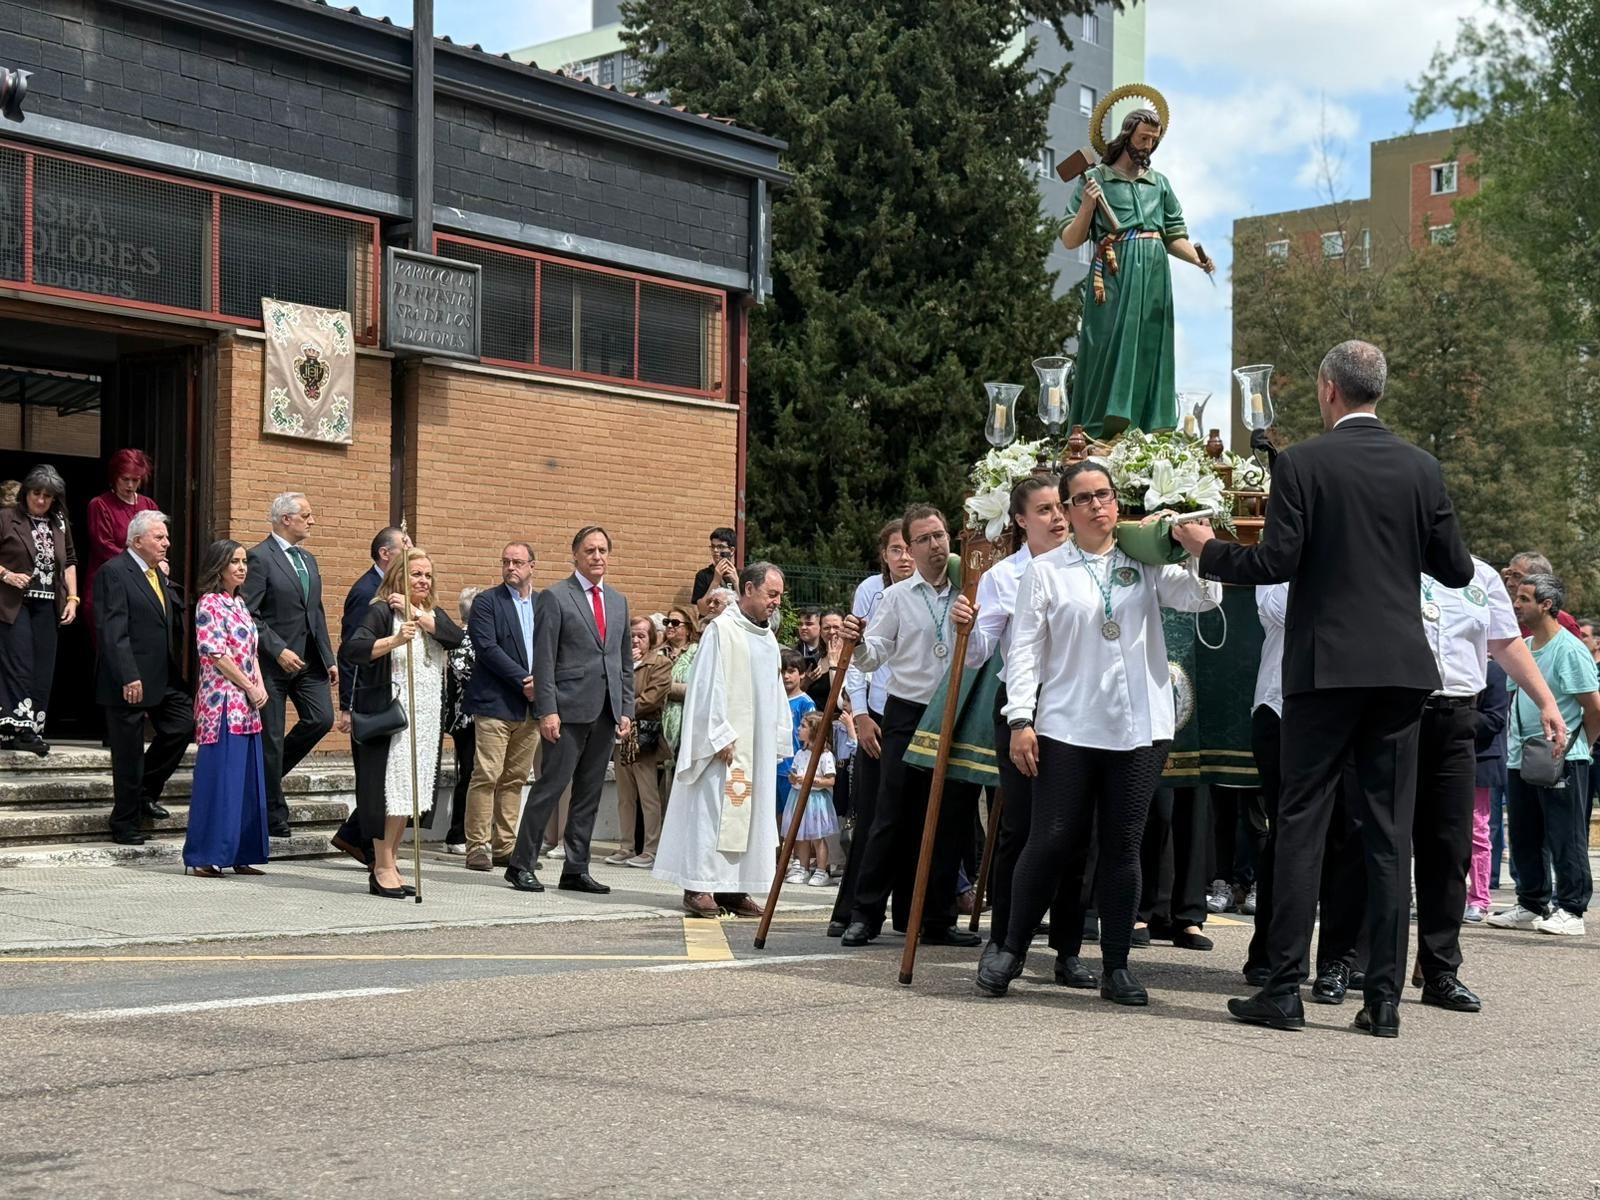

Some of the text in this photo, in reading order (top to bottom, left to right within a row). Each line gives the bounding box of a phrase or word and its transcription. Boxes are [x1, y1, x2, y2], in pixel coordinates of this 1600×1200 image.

[0, 219, 161, 275] DOLORES
[394, 261, 472, 288] PARROQUIA
[392, 281, 474, 309] DE NUESTRA
[424, 308, 444, 323] DE
[446, 311, 473, 328] LOS
[402, 325, 466, 348] DOLORES
